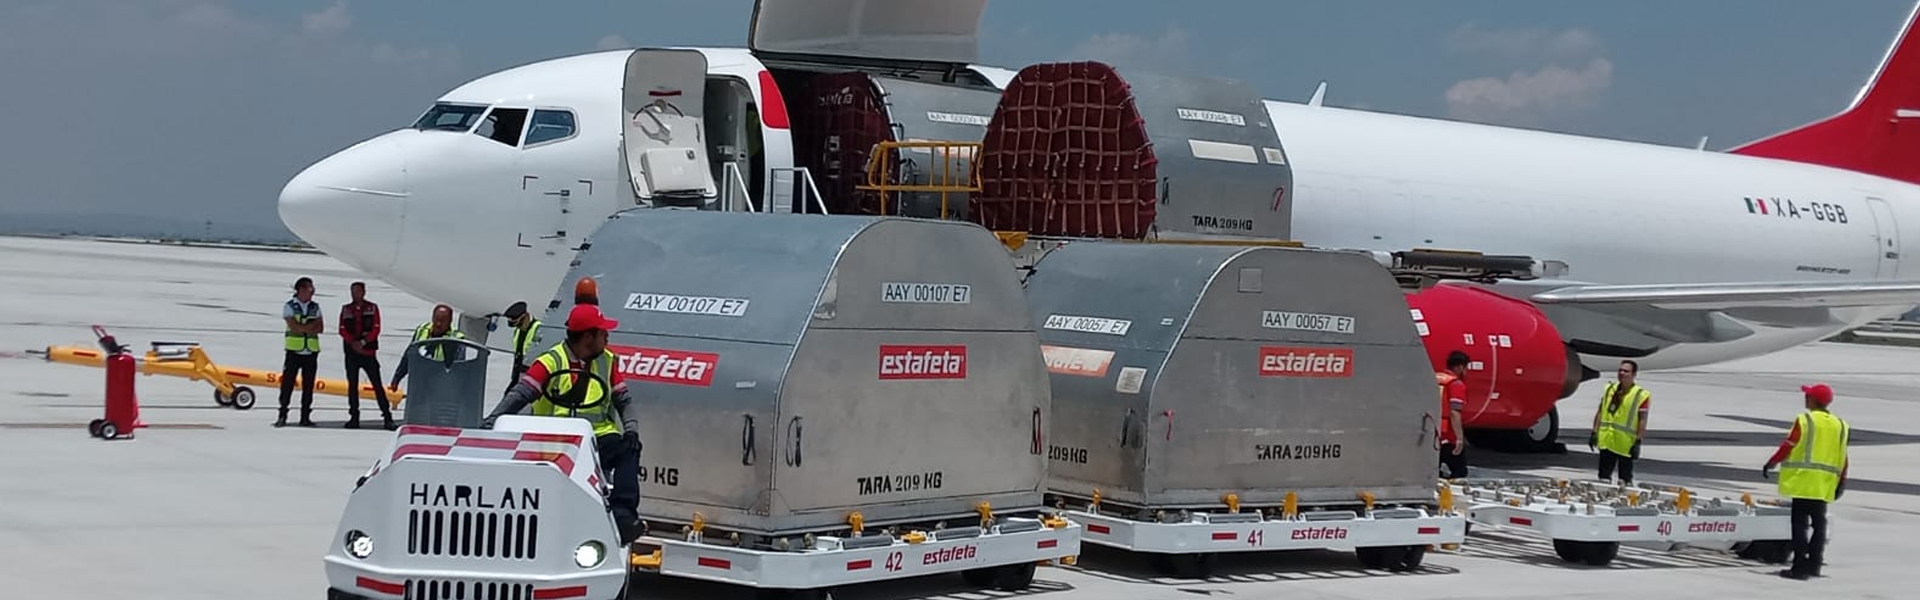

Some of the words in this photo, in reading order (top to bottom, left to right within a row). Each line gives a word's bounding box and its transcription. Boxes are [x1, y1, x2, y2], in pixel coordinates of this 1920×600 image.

[1771, 197, 1848, 224] XA-GGB
[1192, 215, 1218, 229] TARA
[884, 283, 911, 301] AAY
[914, 284, 950, 302] 00107
[952, 286, 968, 302] E7
[628, 294, 666, 310] AAY
[667, 297, 717, 312] 00107
[720, 299, 744, 314] E7
[1046, 315, 1072, 328] AAY
[1073, 317, 1109, 331] 00057
[1110, 320, 1128, 333] E7
[1264, 312, 1291, 327] AAY
[1295, 314, 1331, 330] 00057
[1337, 317, 1352, 332] E7
[618, 352, 706, 381] stafeta
[880, 351, 961, 374] estafeta
[1262, 352, 1346, 373] estafeta
[654, 466, 679, 486] KG
[857, 475, 892, 496] TARA
[895, 474, 920, 491] 209
[923, 471, 943, 489] KG
[410, 483, 540, 510] HARLAN
[1247, 529, 1264, 546] 41
[1291, 527, 1348, 540] estafeta
[1656, 521, 1672, 536] 40
[1688, 521, 1737, 533] estafeta
[885, 551, 903, 572] 42
[923, 544, 976, 566] estafeta
